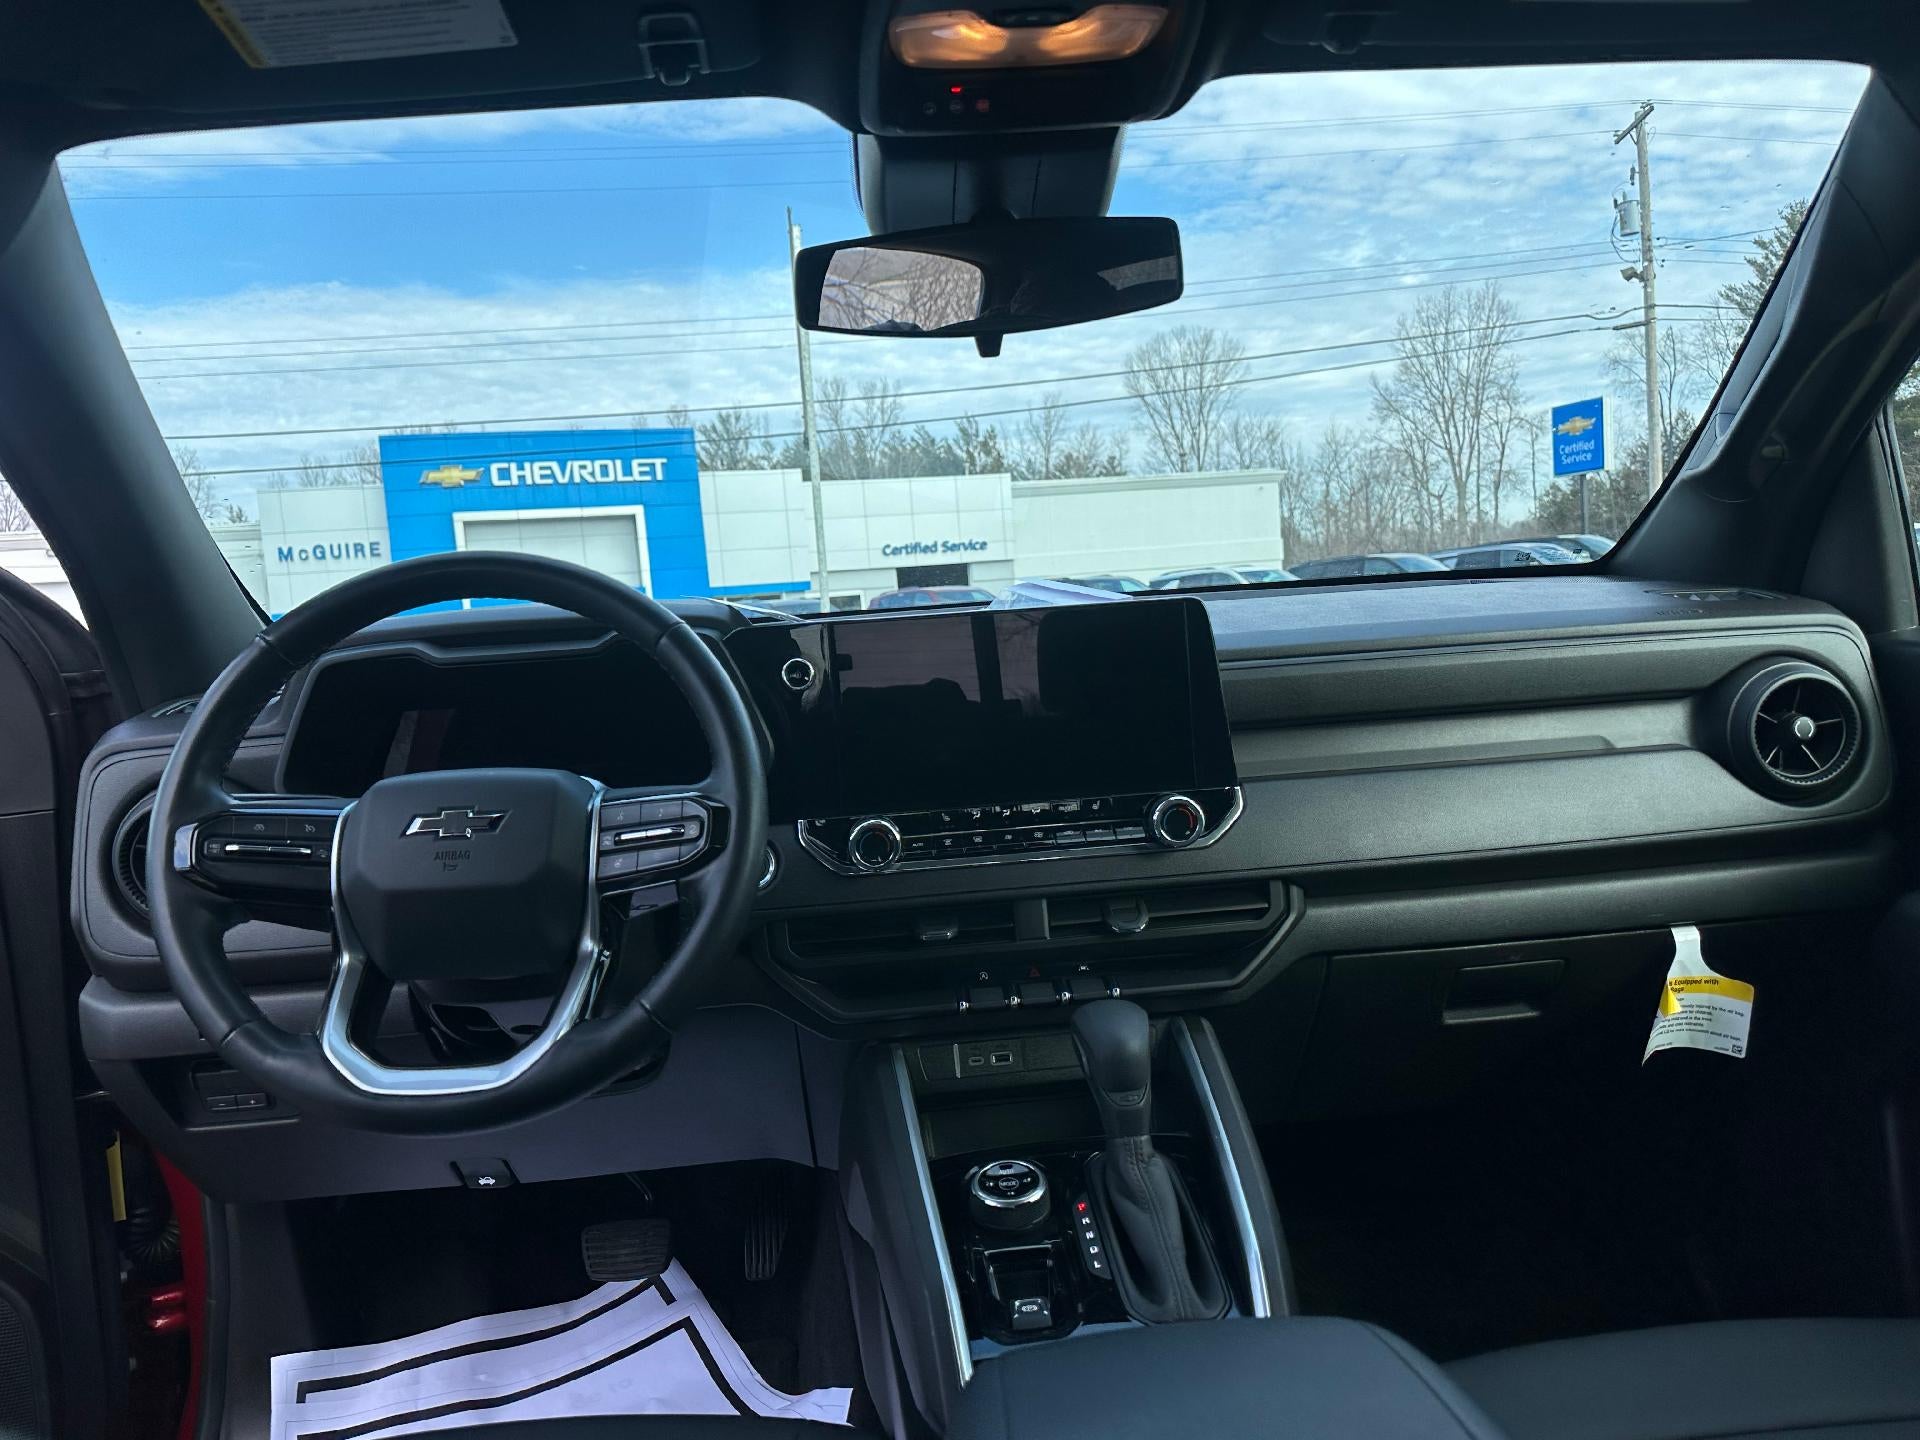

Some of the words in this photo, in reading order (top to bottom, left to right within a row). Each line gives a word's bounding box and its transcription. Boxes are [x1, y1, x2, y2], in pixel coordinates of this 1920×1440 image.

[1559, 440, 1595, 454] Certified
[1561, 452, 1593, 465] Service
[489, 457, 668, 487] CHEVROLET
[277, 540, 382, 563] McGUIRE
[882, 541, 938, 556] Certified
[941, 539, 988, 553] Service
[433, 849, 471, 861] AIRBAG
[1674, 979, 1702, 987] Equipped
[1077, 1203, 1086, 1211] P
[1085, 1231, 1094, 1239] N
[1089, 1245, 1099, 1254] D
[1094, 1260, 1102, 1269] L
